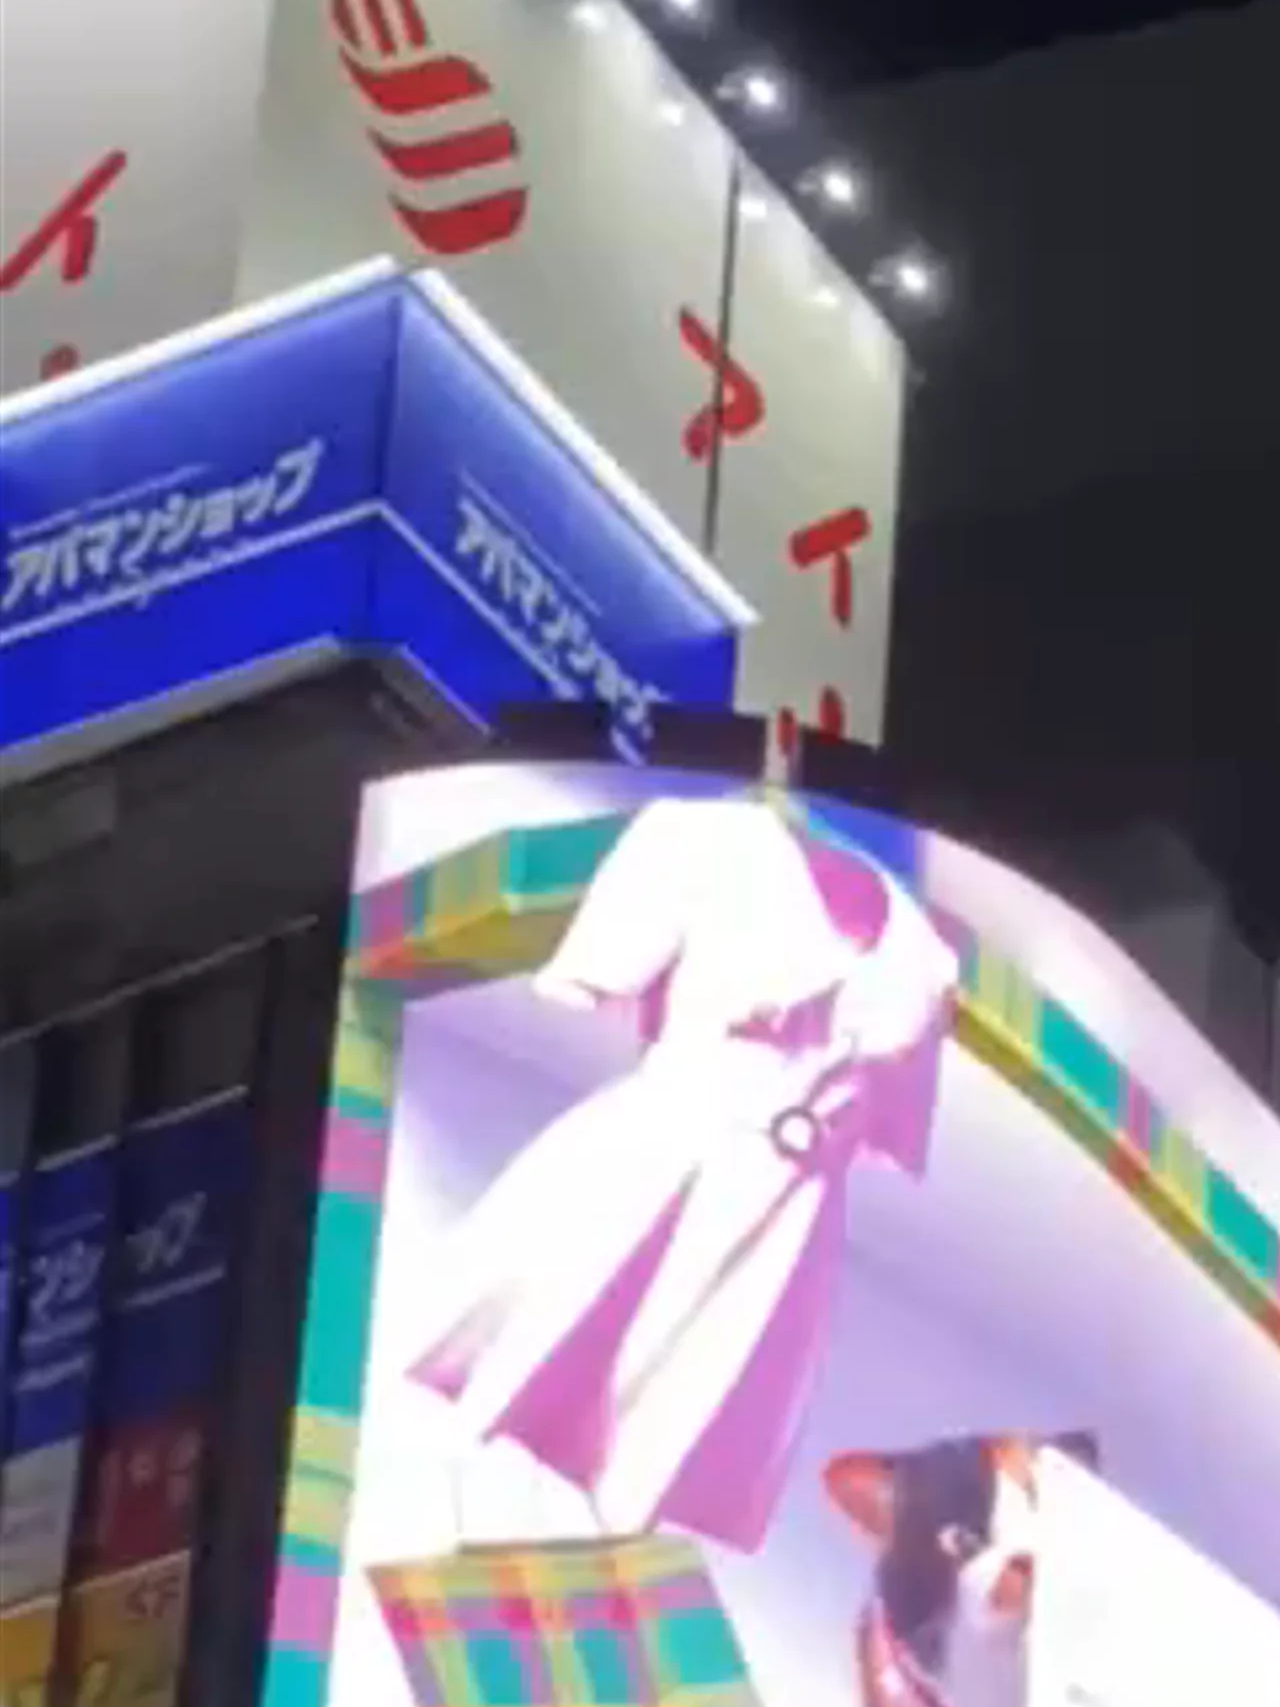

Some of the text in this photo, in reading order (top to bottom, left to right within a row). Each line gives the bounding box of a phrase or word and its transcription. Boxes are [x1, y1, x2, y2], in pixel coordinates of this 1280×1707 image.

[2, 436, 326, 611] アパマンショップ
